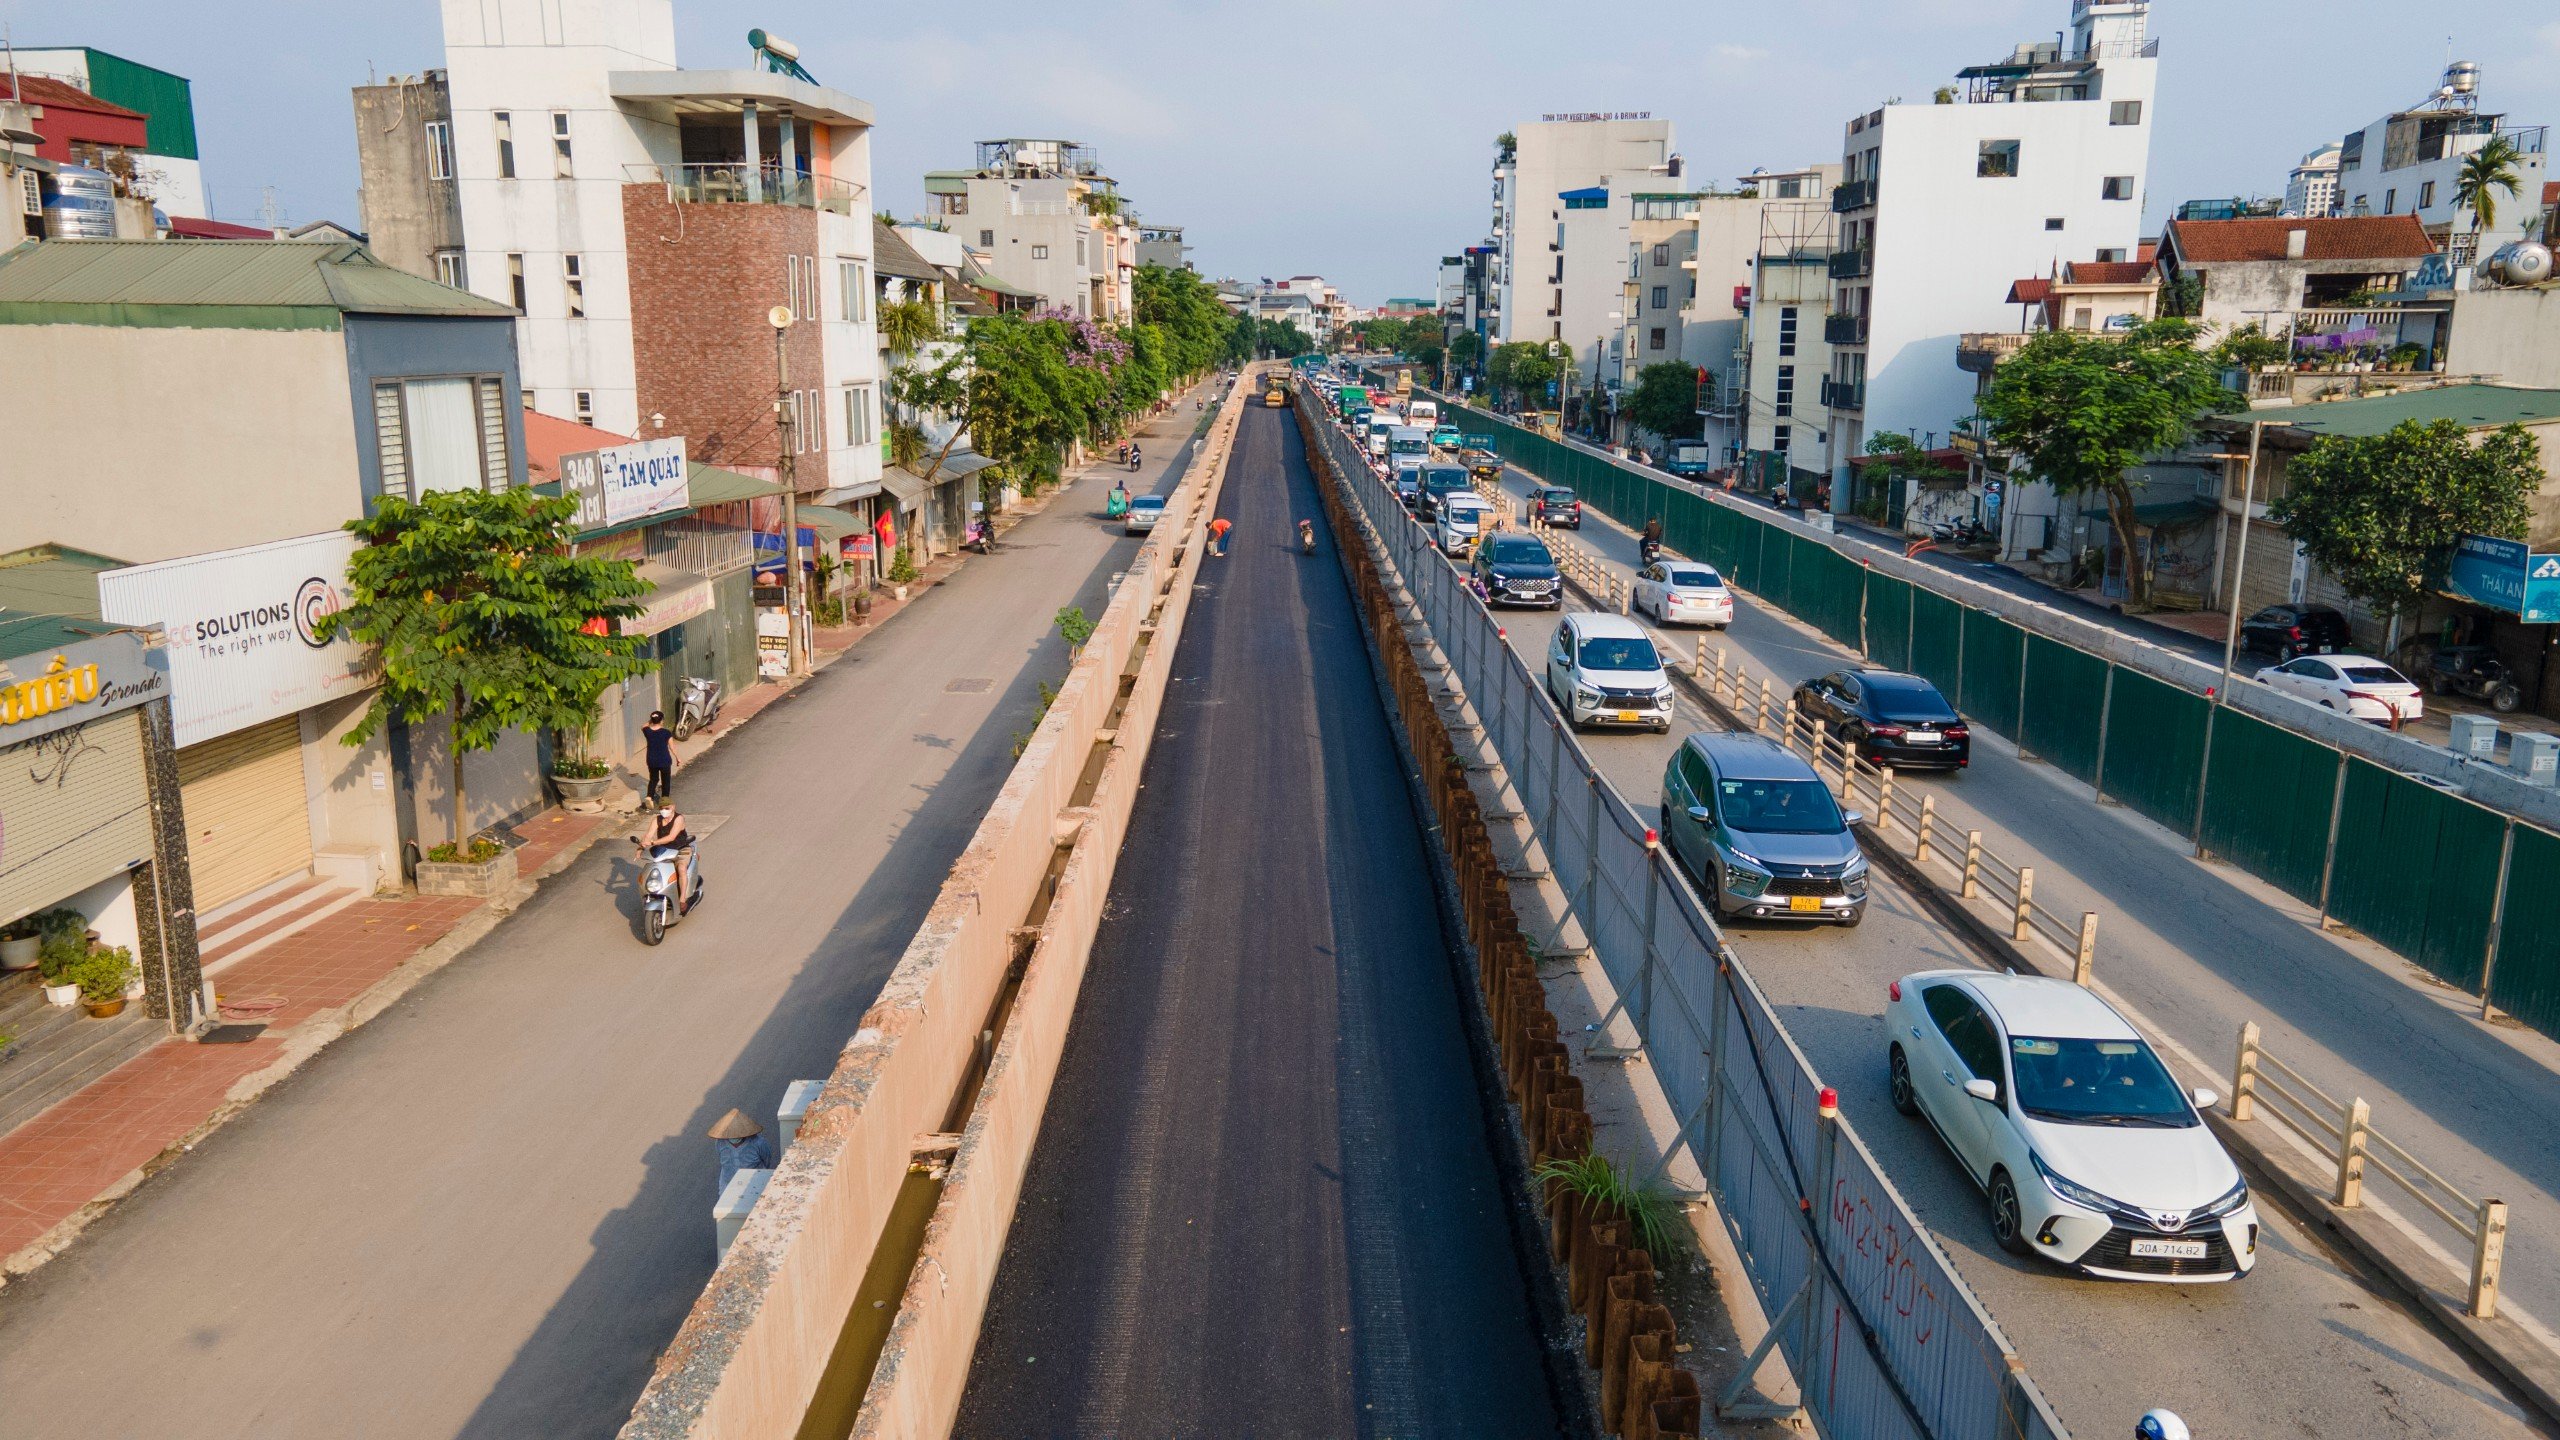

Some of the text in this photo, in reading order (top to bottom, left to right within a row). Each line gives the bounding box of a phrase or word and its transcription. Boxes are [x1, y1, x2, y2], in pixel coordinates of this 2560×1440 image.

[567, 457, 596, 490] 348
[196, 602, 291, 641] SOLUTIONS
[199, 627, 293, 660] The right way
[100, 671, 163, 708] Serenade
[2137, 1243, 2200, 1256] 20A-714.82
